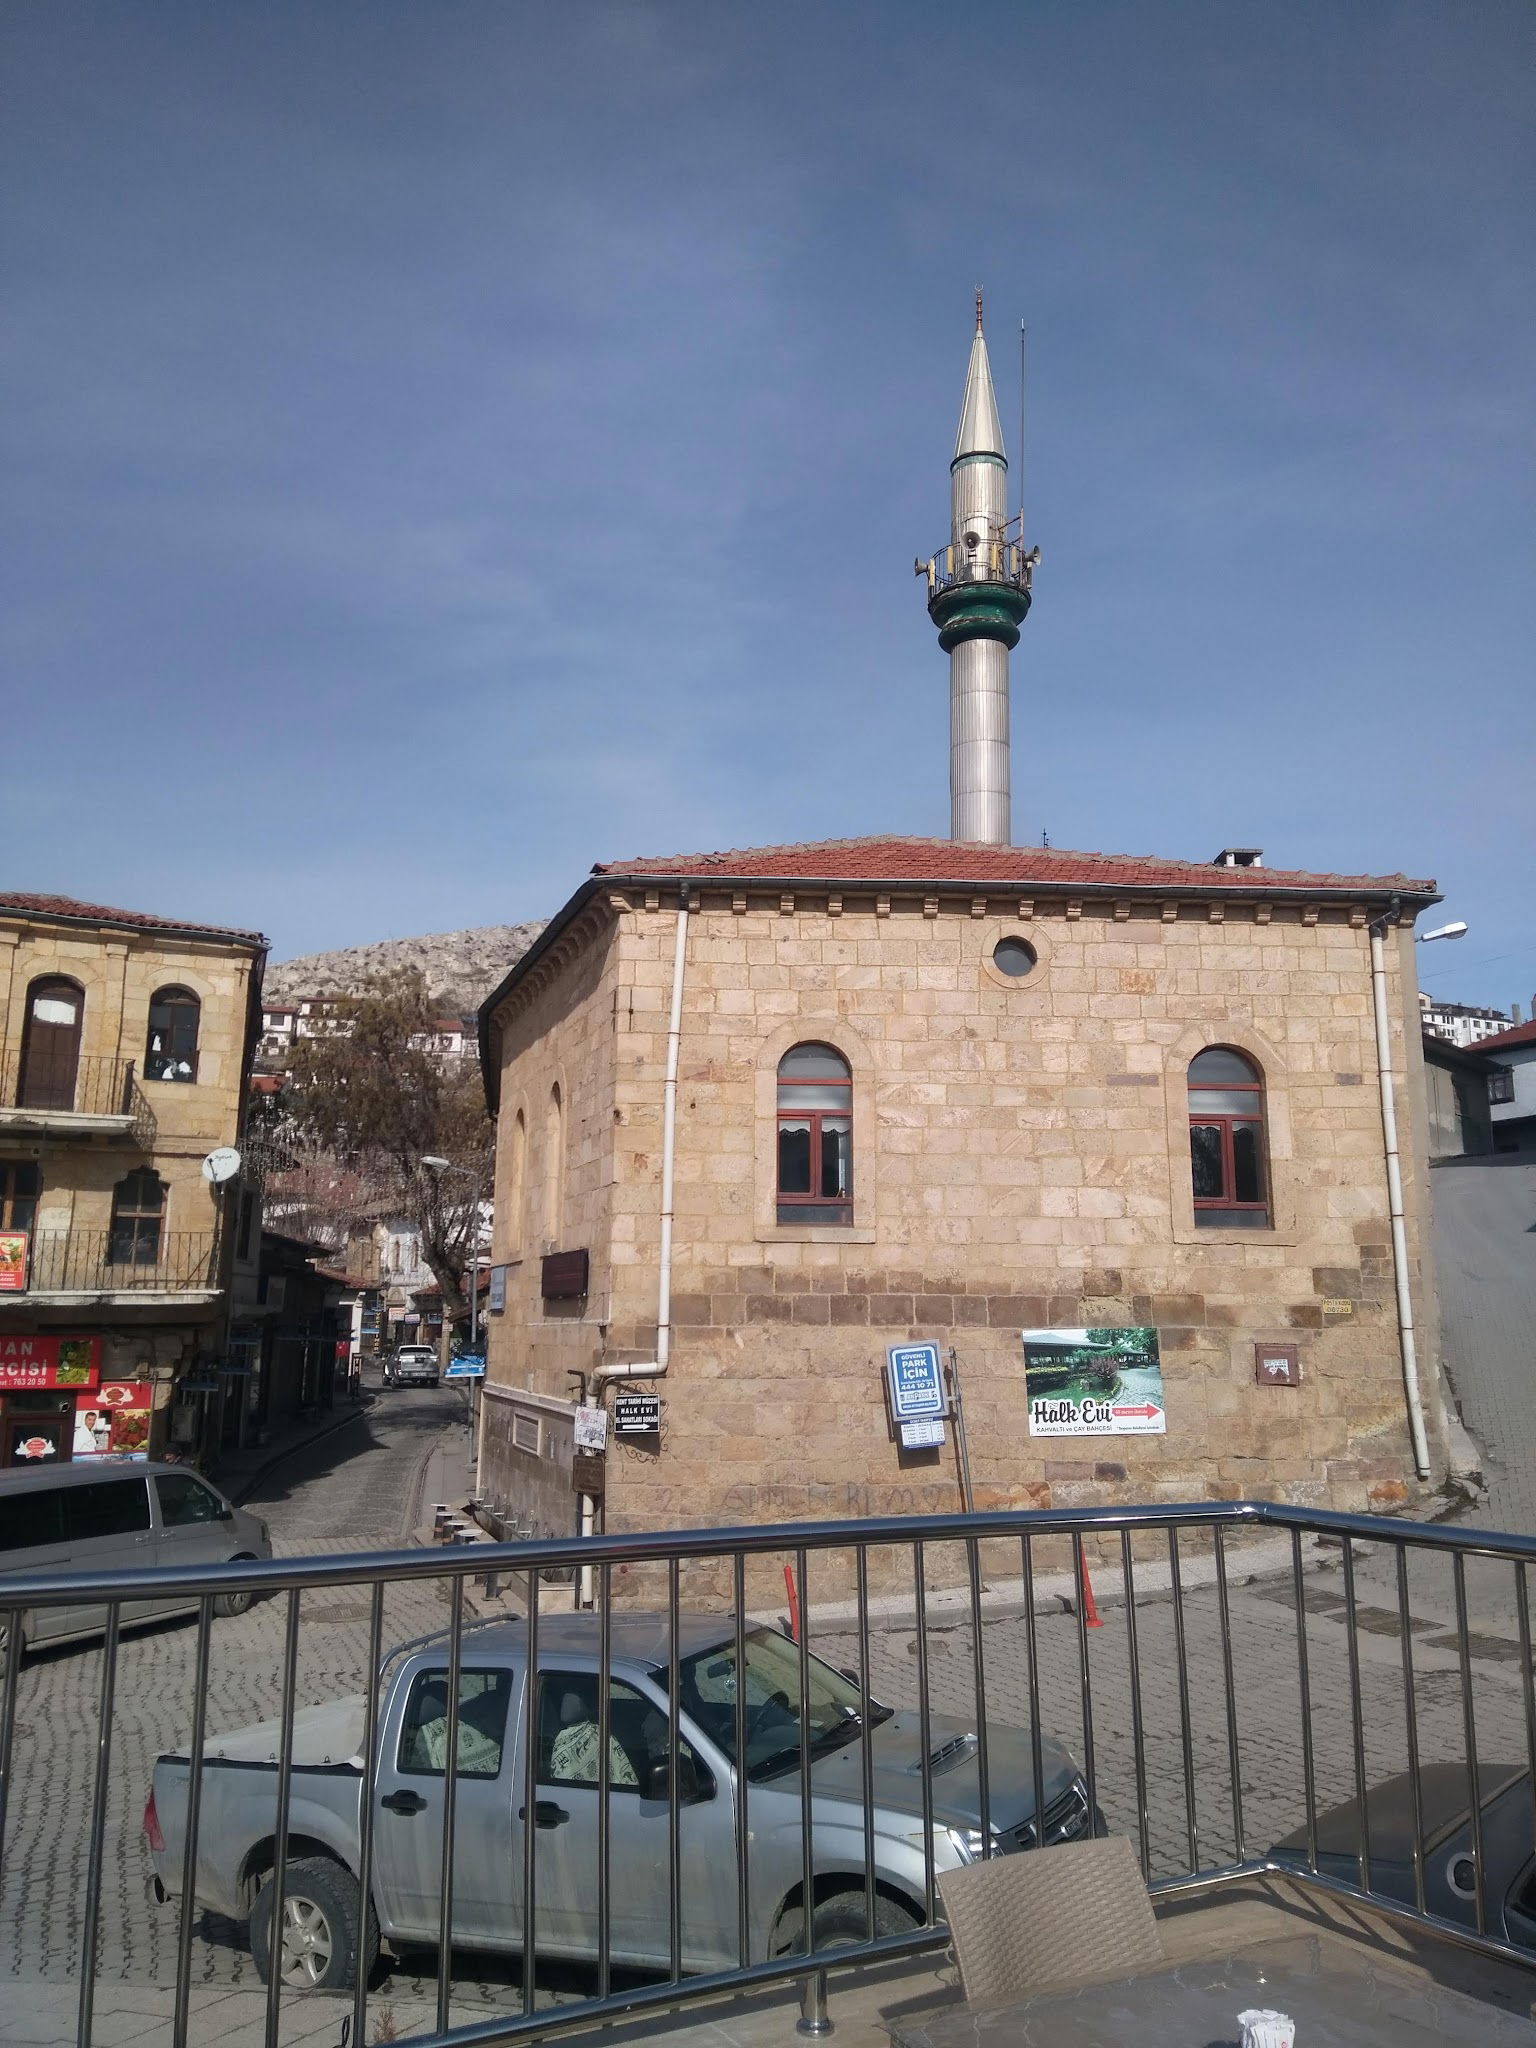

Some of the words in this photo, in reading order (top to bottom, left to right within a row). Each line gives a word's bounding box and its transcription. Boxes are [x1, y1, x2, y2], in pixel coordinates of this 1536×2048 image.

[0, 1341, 33, 1355] AN
[901, 1352, 926, 1360] GÜVENLİ
[902, 1359, 927, 1368] PARK
[903, 1367, 928, 1380] İÇİN
[13, 1378, 26, 1386] 763
[27, 1378, 36, 1386] 20
[37, 1378, 46, 1386] 50
[640, 1405, 653, 1414] EVİ
[1034, 1401, 1078, 1424] Halk
[1082, 1400, 1113, 1424] Evi
[1036, 1425, 1065, 1433] KAHVALTI
[1073, 1425, 1086, 1433] ÇAY
[1086, 1424, 1113, 1433] BAHÇESİ
